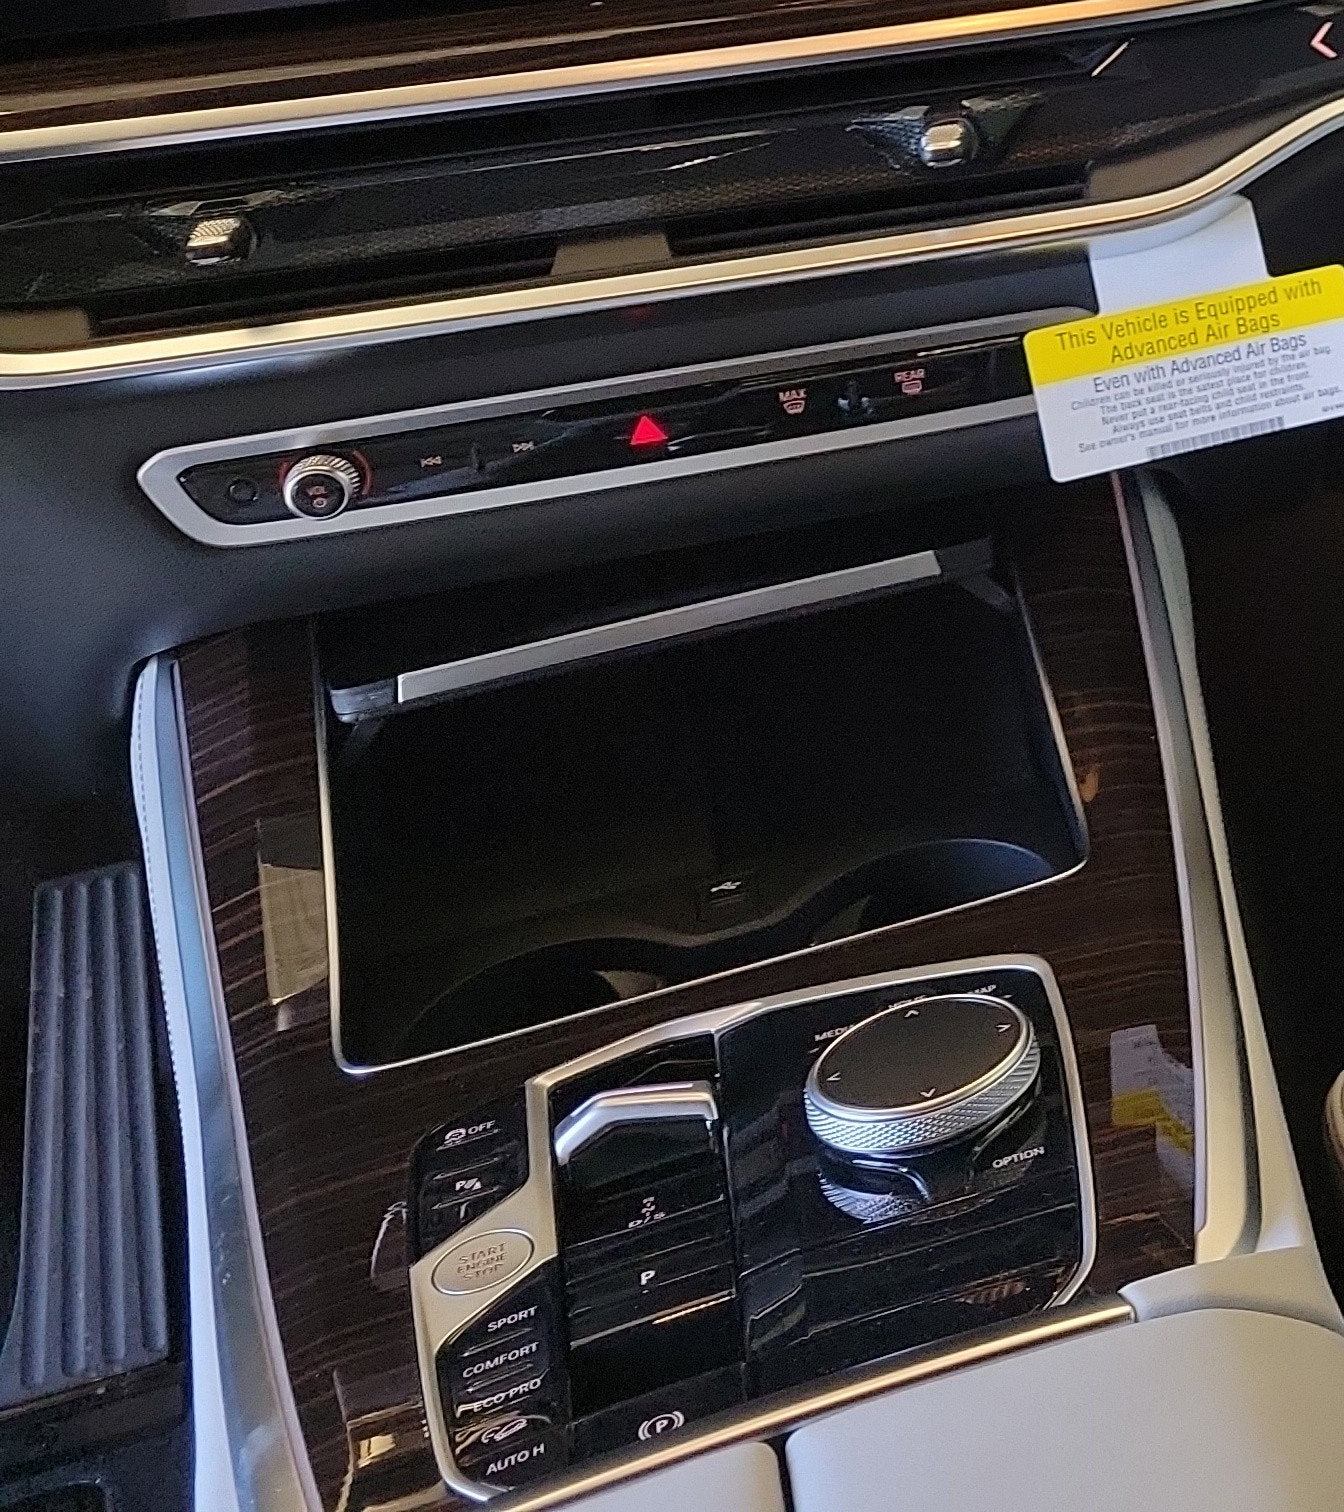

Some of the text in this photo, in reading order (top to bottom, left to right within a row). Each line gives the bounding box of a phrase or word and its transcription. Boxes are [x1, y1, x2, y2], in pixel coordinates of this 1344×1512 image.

[1056, 278, 1323, 351] This Vehicle is Equipped with
[1111, 313, 1281, 364] Advanced Air Bags
[1093, 334, 1308, 393] Even with Advanced Air Bags
[467, 1120, 496, 1135] OFF
[992, 1146, 1045, 1168] OPTION
[457, 1252, 506, 1274] ENGINE
[458, 1240, 507, 1265] START
[640, 1270, 656, 1285] P
[487, 1305, 539, 1332] SPORT
[462, 1341, 540, 1378] COMFORT
[473, 1378, 542, 1413] ECO PRO
[485, 1443, 545, 1476] AUTO H
